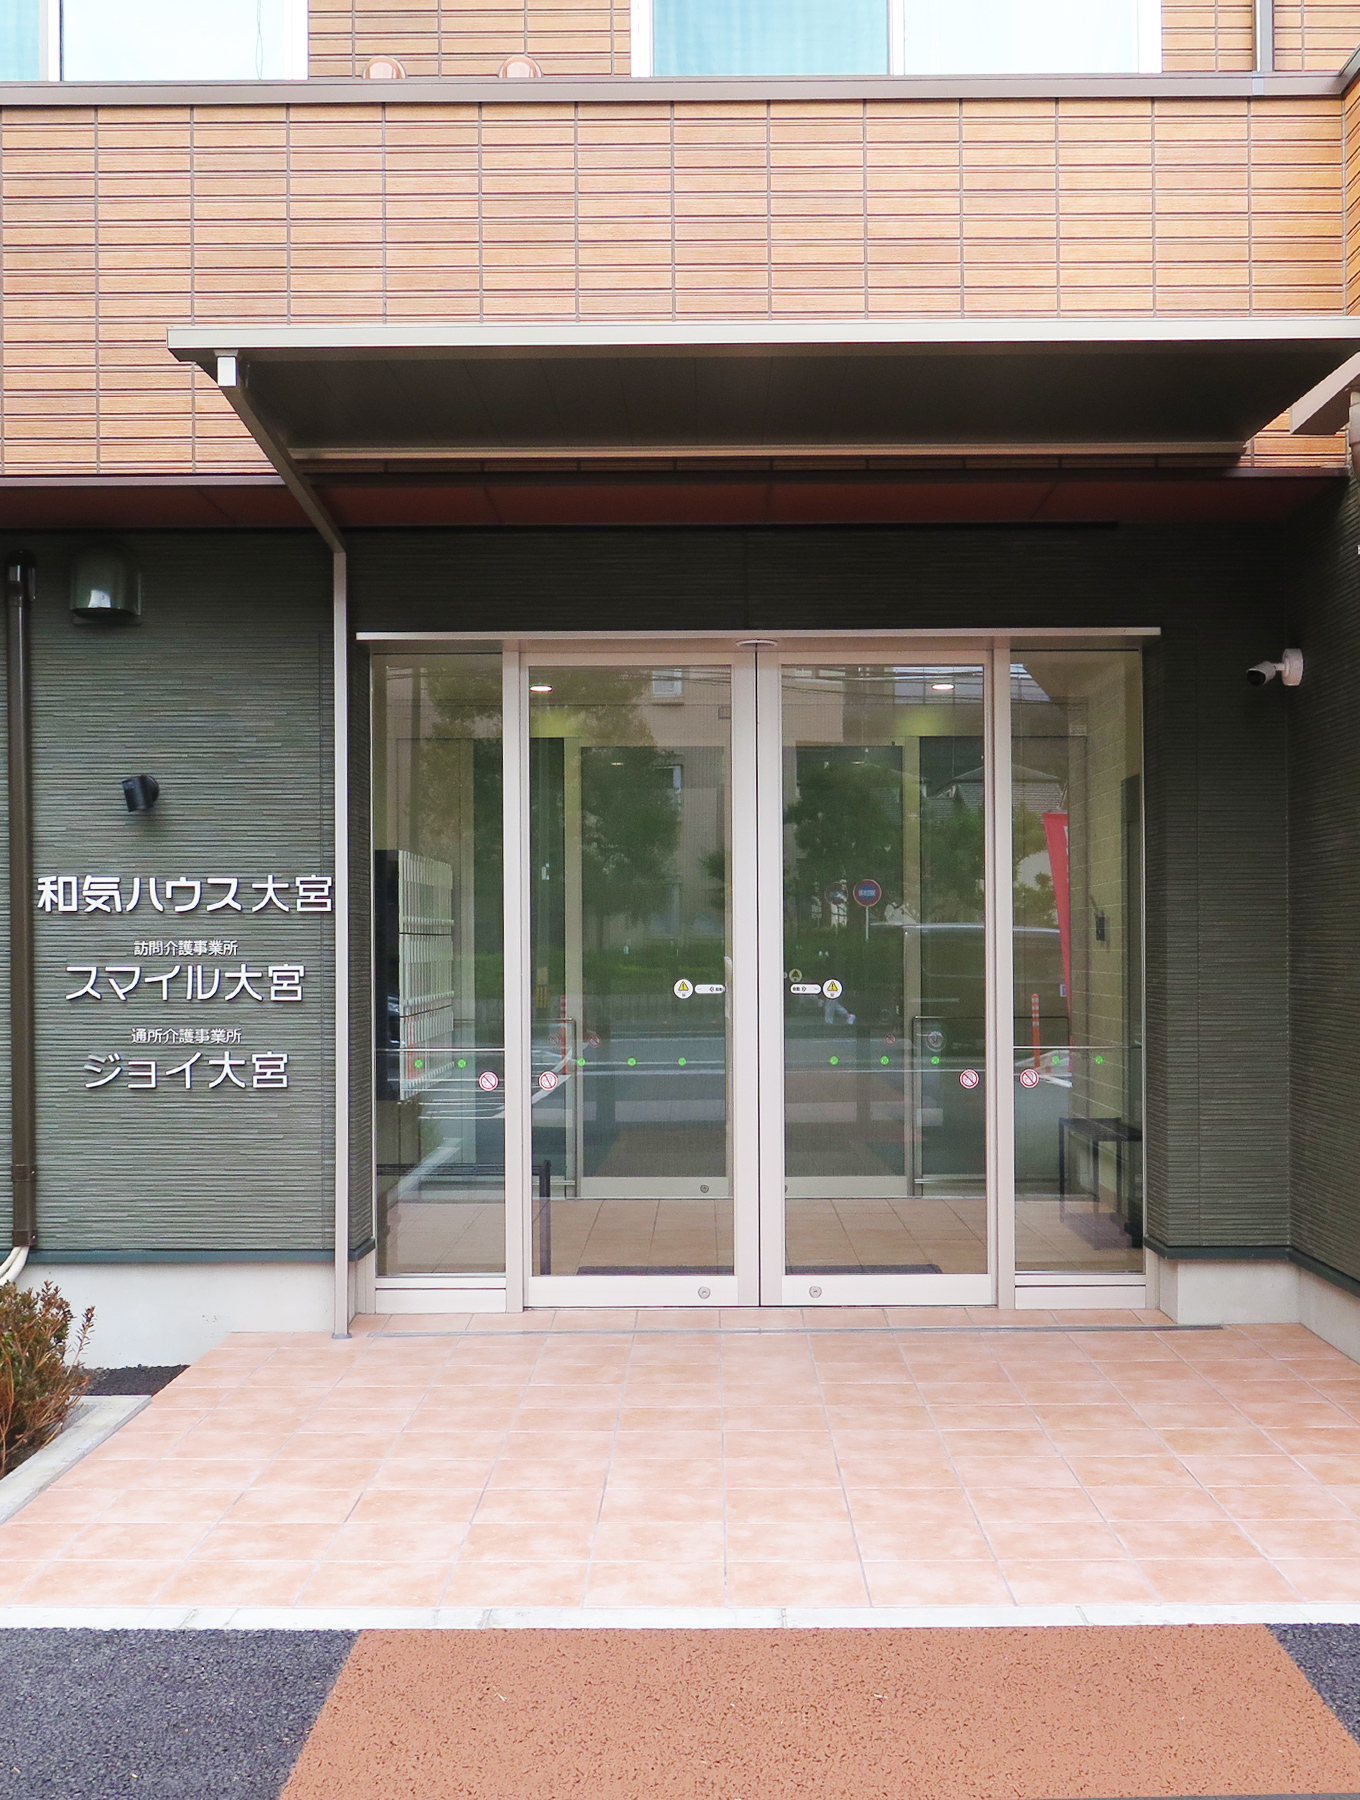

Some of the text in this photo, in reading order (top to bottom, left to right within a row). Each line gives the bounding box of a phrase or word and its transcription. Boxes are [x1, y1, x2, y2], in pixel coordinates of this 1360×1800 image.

[37, 875, 333, 913] 和気ハウス大宮
[133, 940, 239, 956] 訪問介護事業所
[65, 964, 304, 1001] スマイル大宮
[131, 1028, 242, 1044] 通所介護事業所
[83, 1051, 289, 1090] ジョイ大宮
